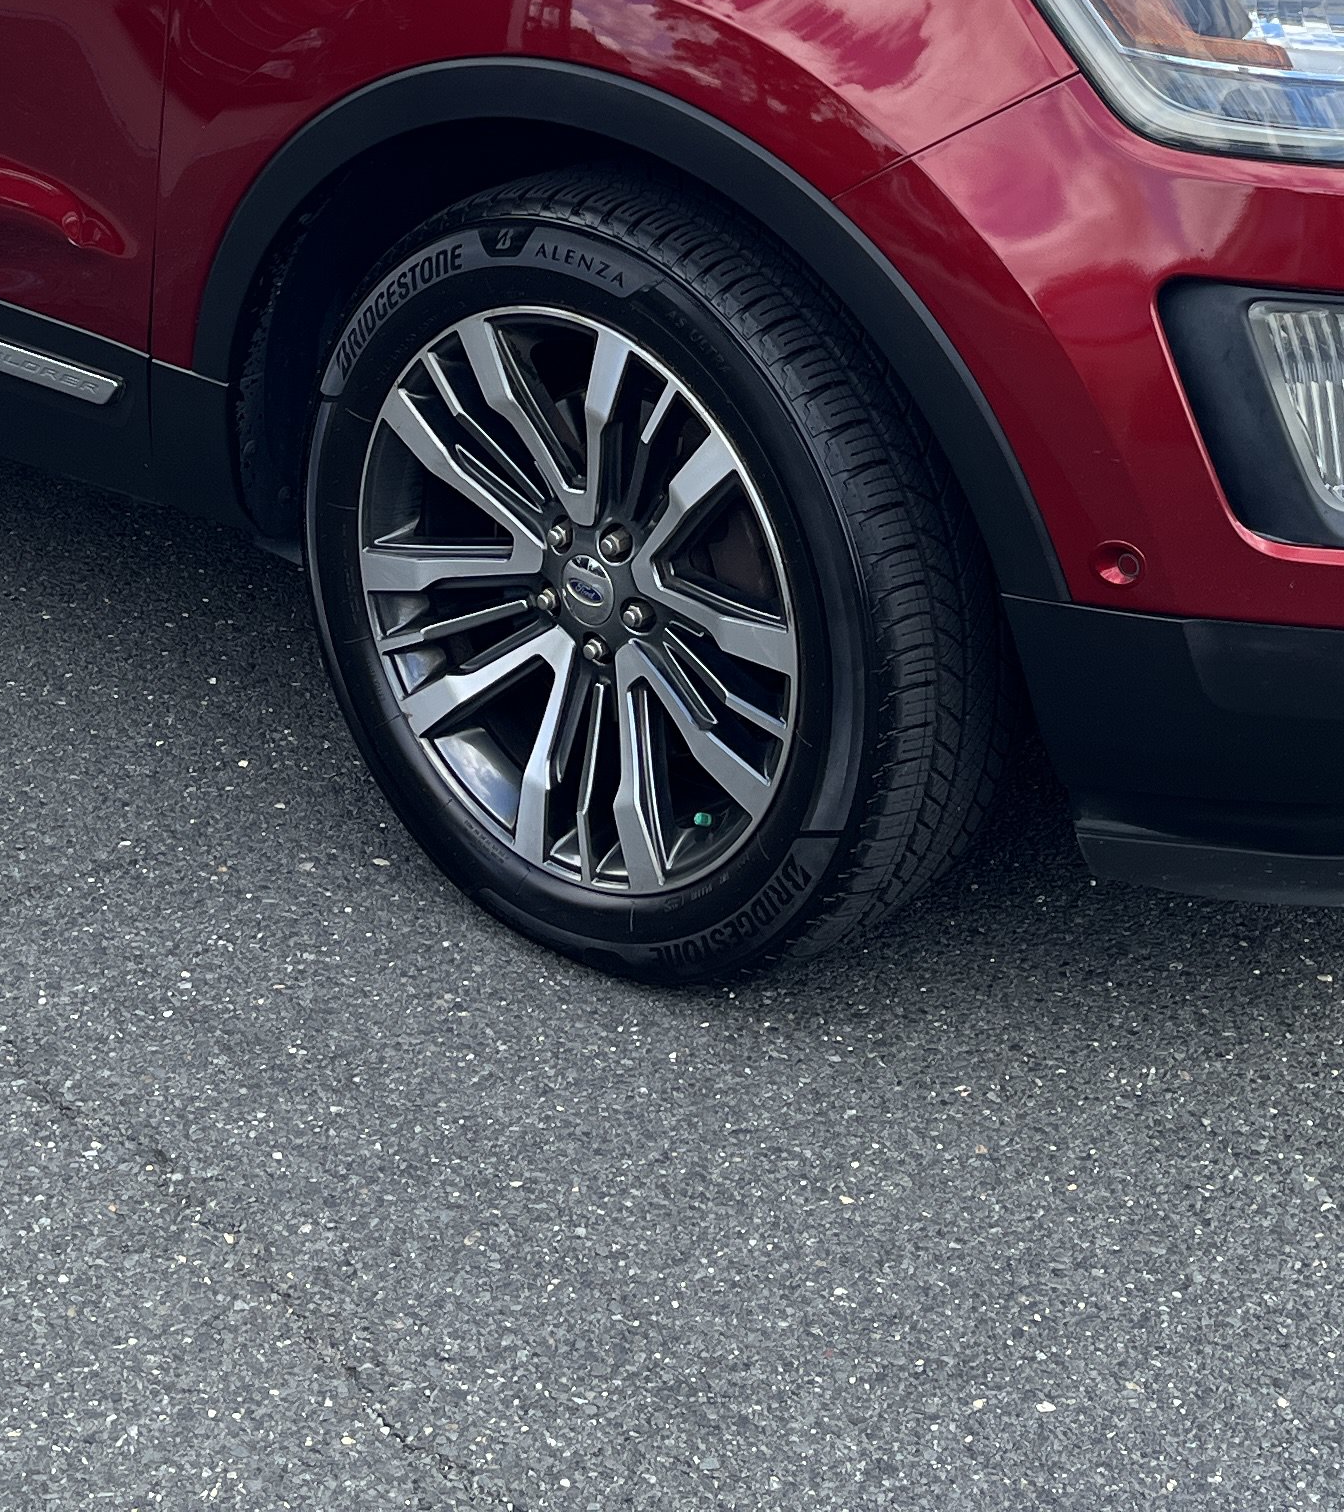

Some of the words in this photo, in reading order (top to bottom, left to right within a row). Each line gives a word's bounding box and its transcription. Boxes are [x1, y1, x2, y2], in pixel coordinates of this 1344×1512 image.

[336, 243, 464, 381] BRIDGESTONE
[534, 243, 625, 289] ALENZA
[651, 853, 813, 969] BRIDGESTONE
